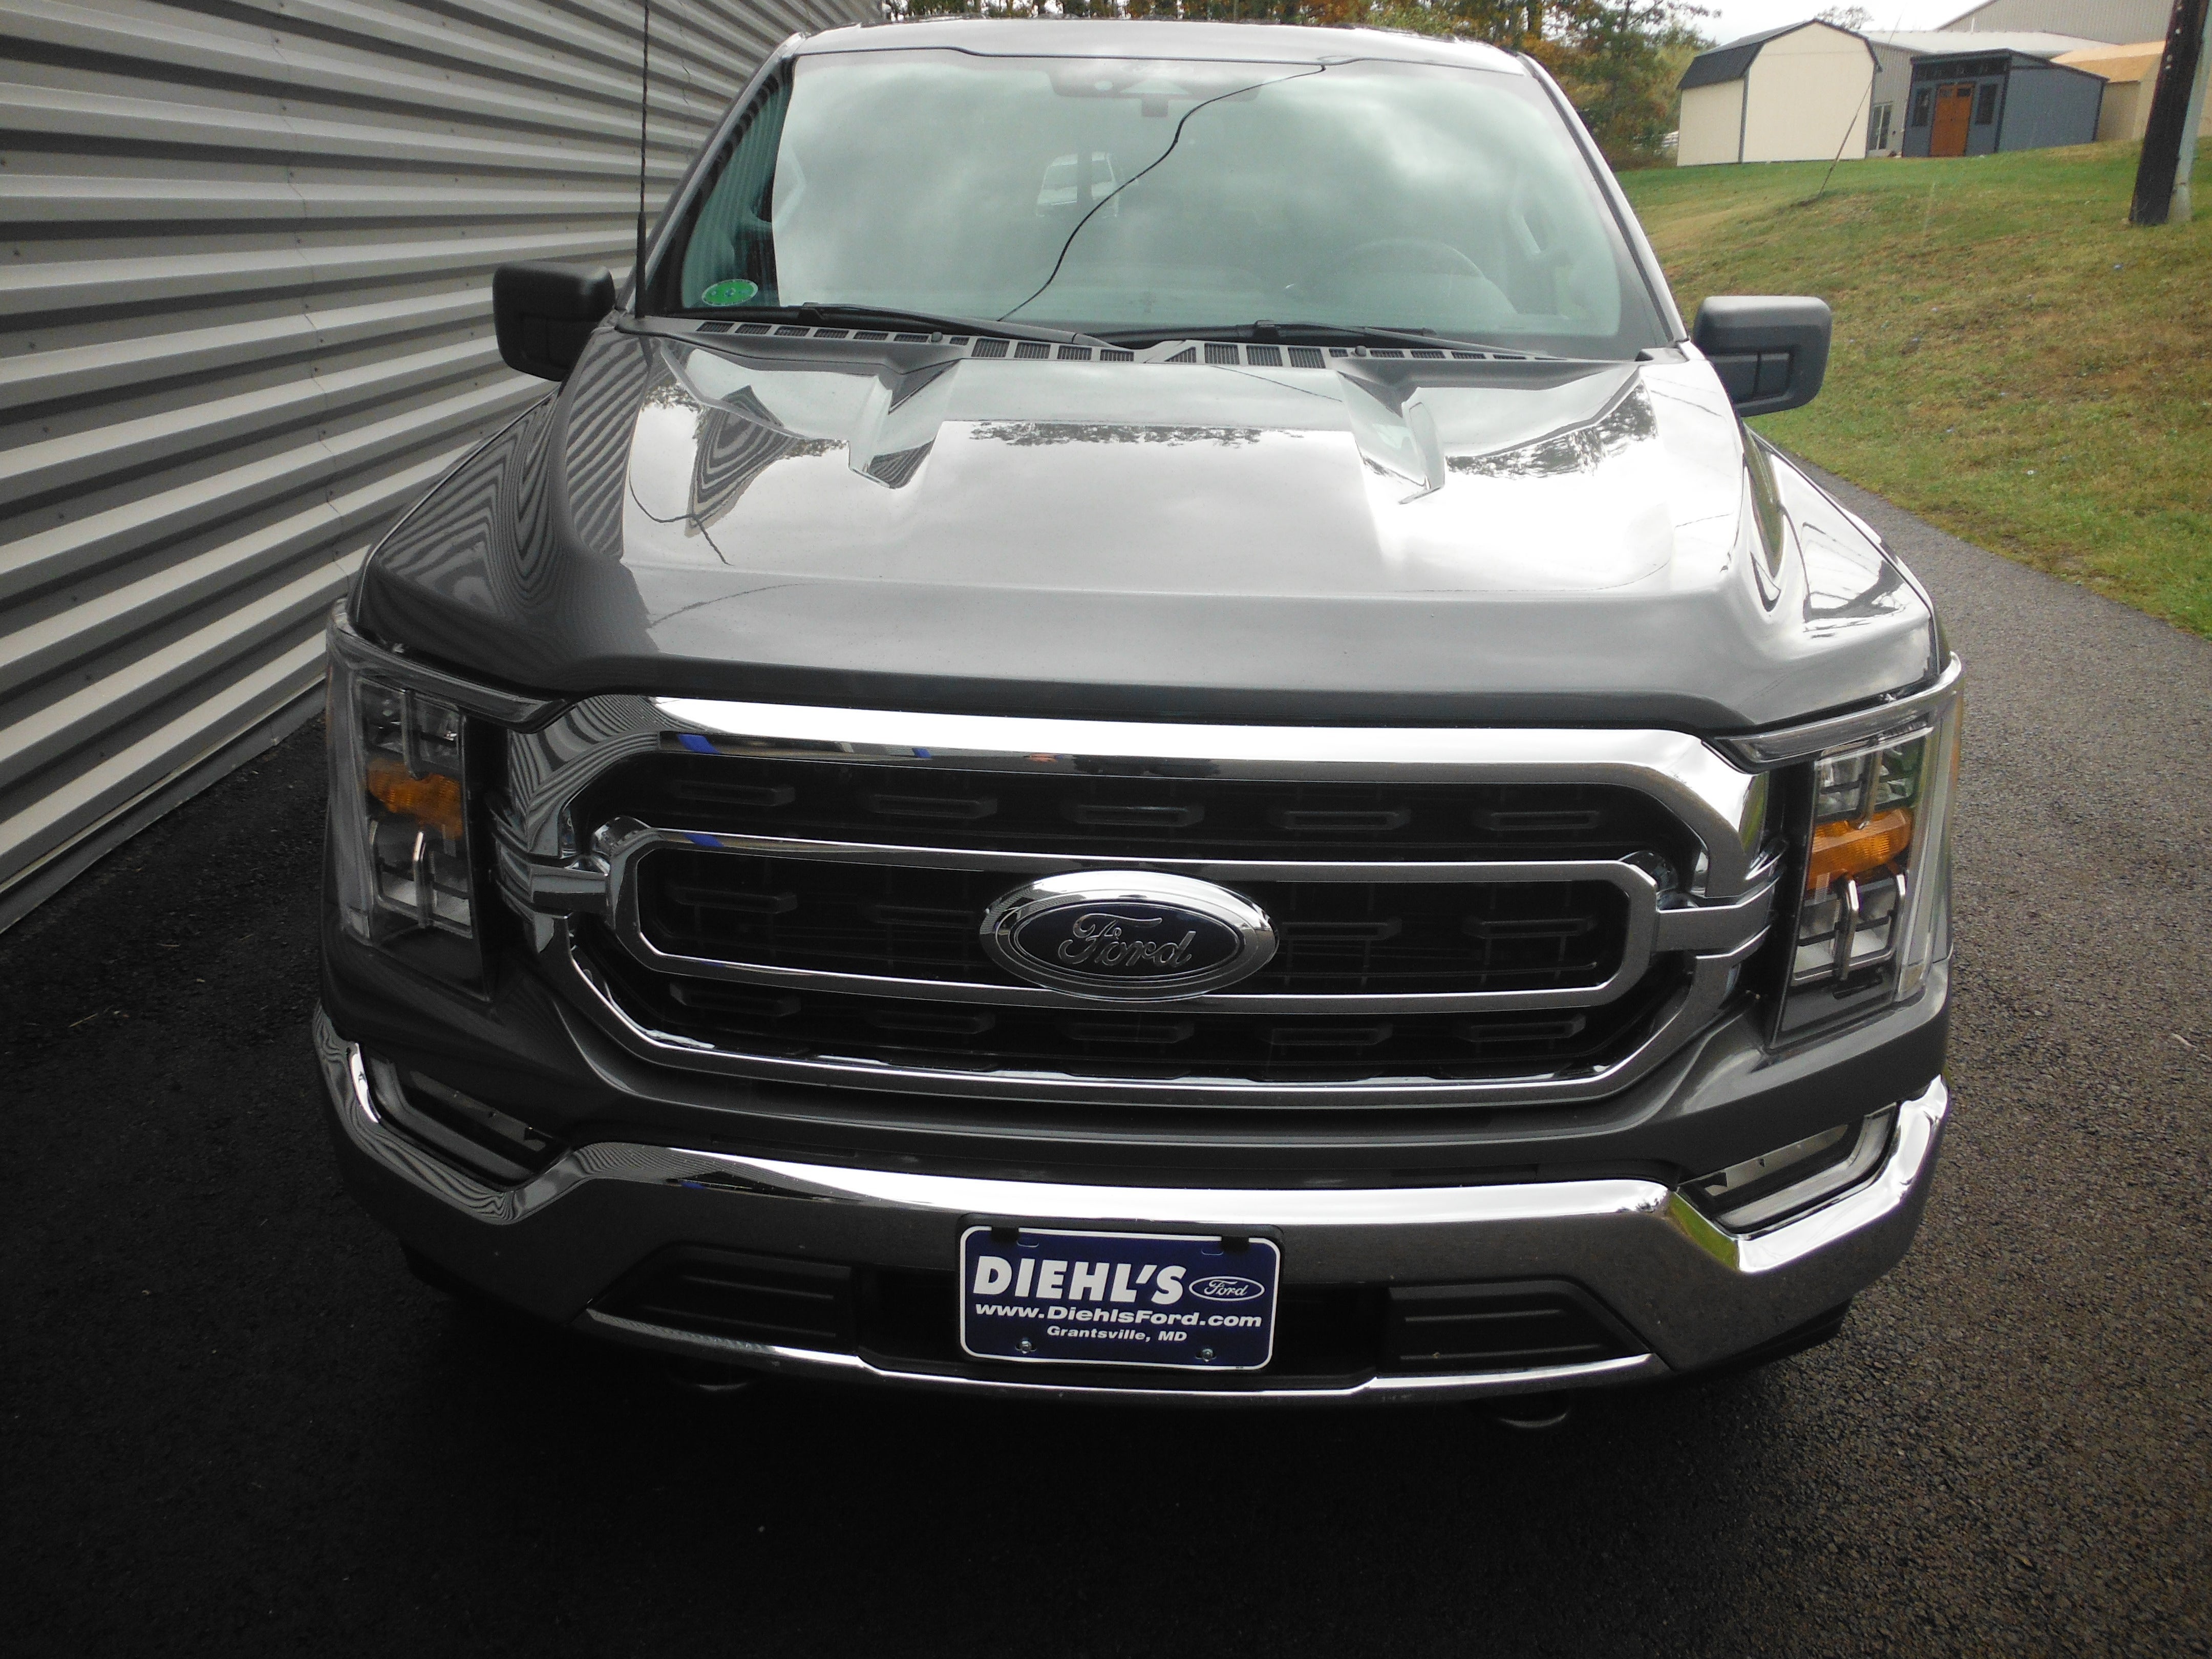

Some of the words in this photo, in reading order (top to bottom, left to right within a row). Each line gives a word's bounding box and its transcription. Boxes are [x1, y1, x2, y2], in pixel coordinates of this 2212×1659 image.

[1058, 912, 1196, 968] Ford
[973, 1256, 1187, 1305] DIEHL'S
[1203, 1280, 1248, 1296] Ford
[975, 1303, 1262, 1327] www.DiehlsFord.com
[1047, 1325, 1151, 1343] Grantsville,
[1158, 1330, 1187, 1342] MD
